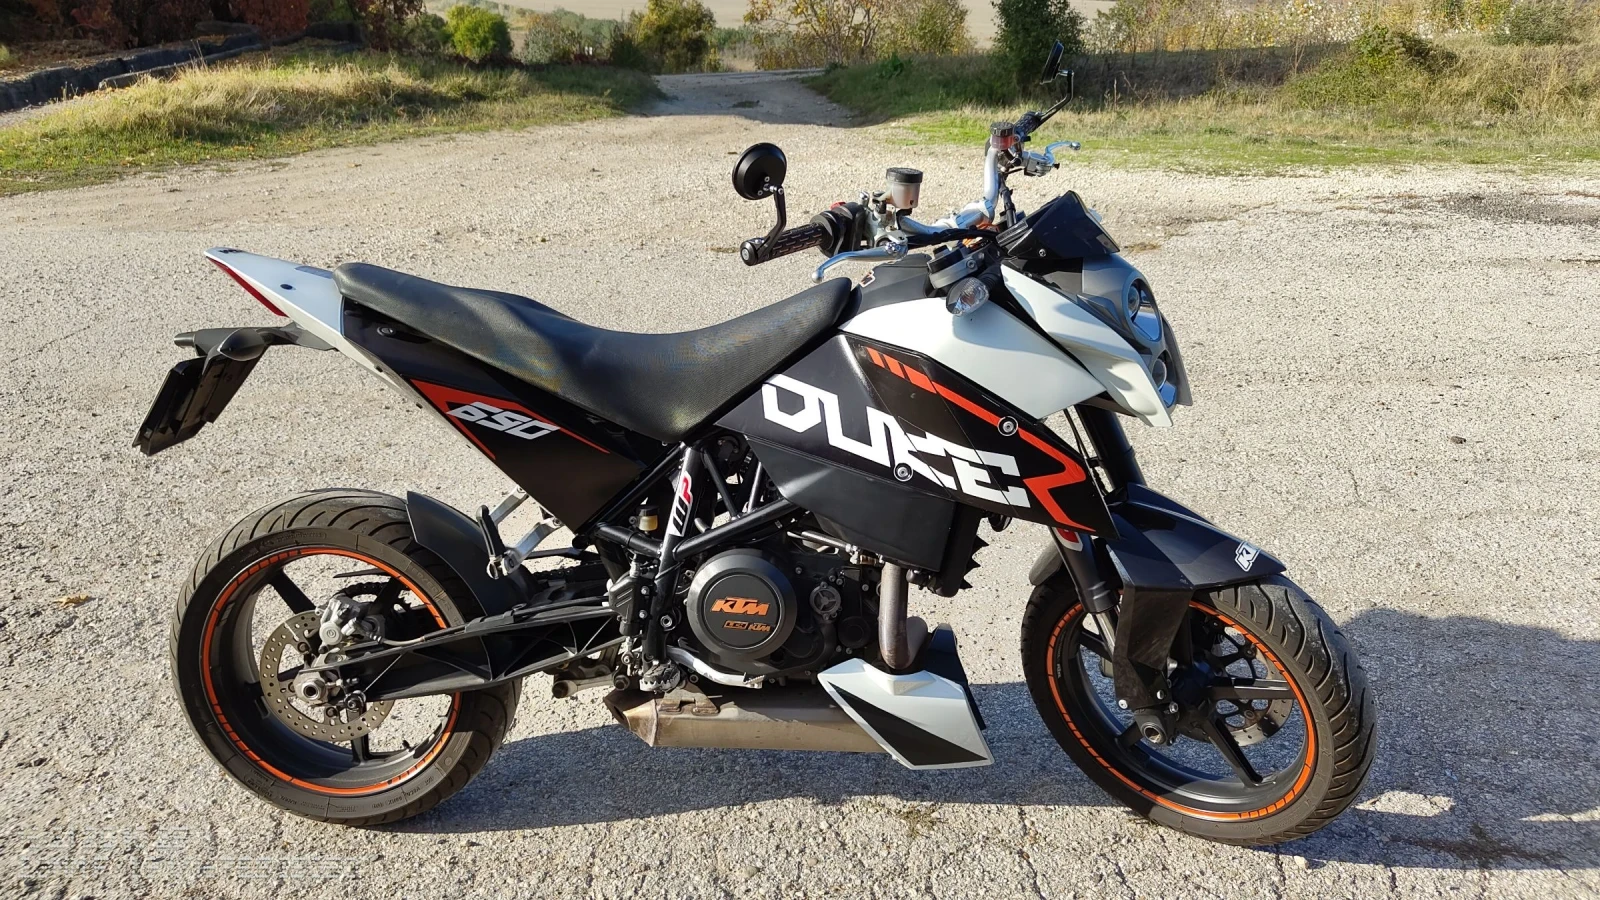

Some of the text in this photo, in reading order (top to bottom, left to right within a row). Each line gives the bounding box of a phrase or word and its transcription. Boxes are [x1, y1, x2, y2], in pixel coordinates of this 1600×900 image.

[446, 401, 560, 440] 690
[761, 373, 1031, 508] DUKE
[711, 597, 770, 616] KTM
[748, 622, 771, 632] KTM
